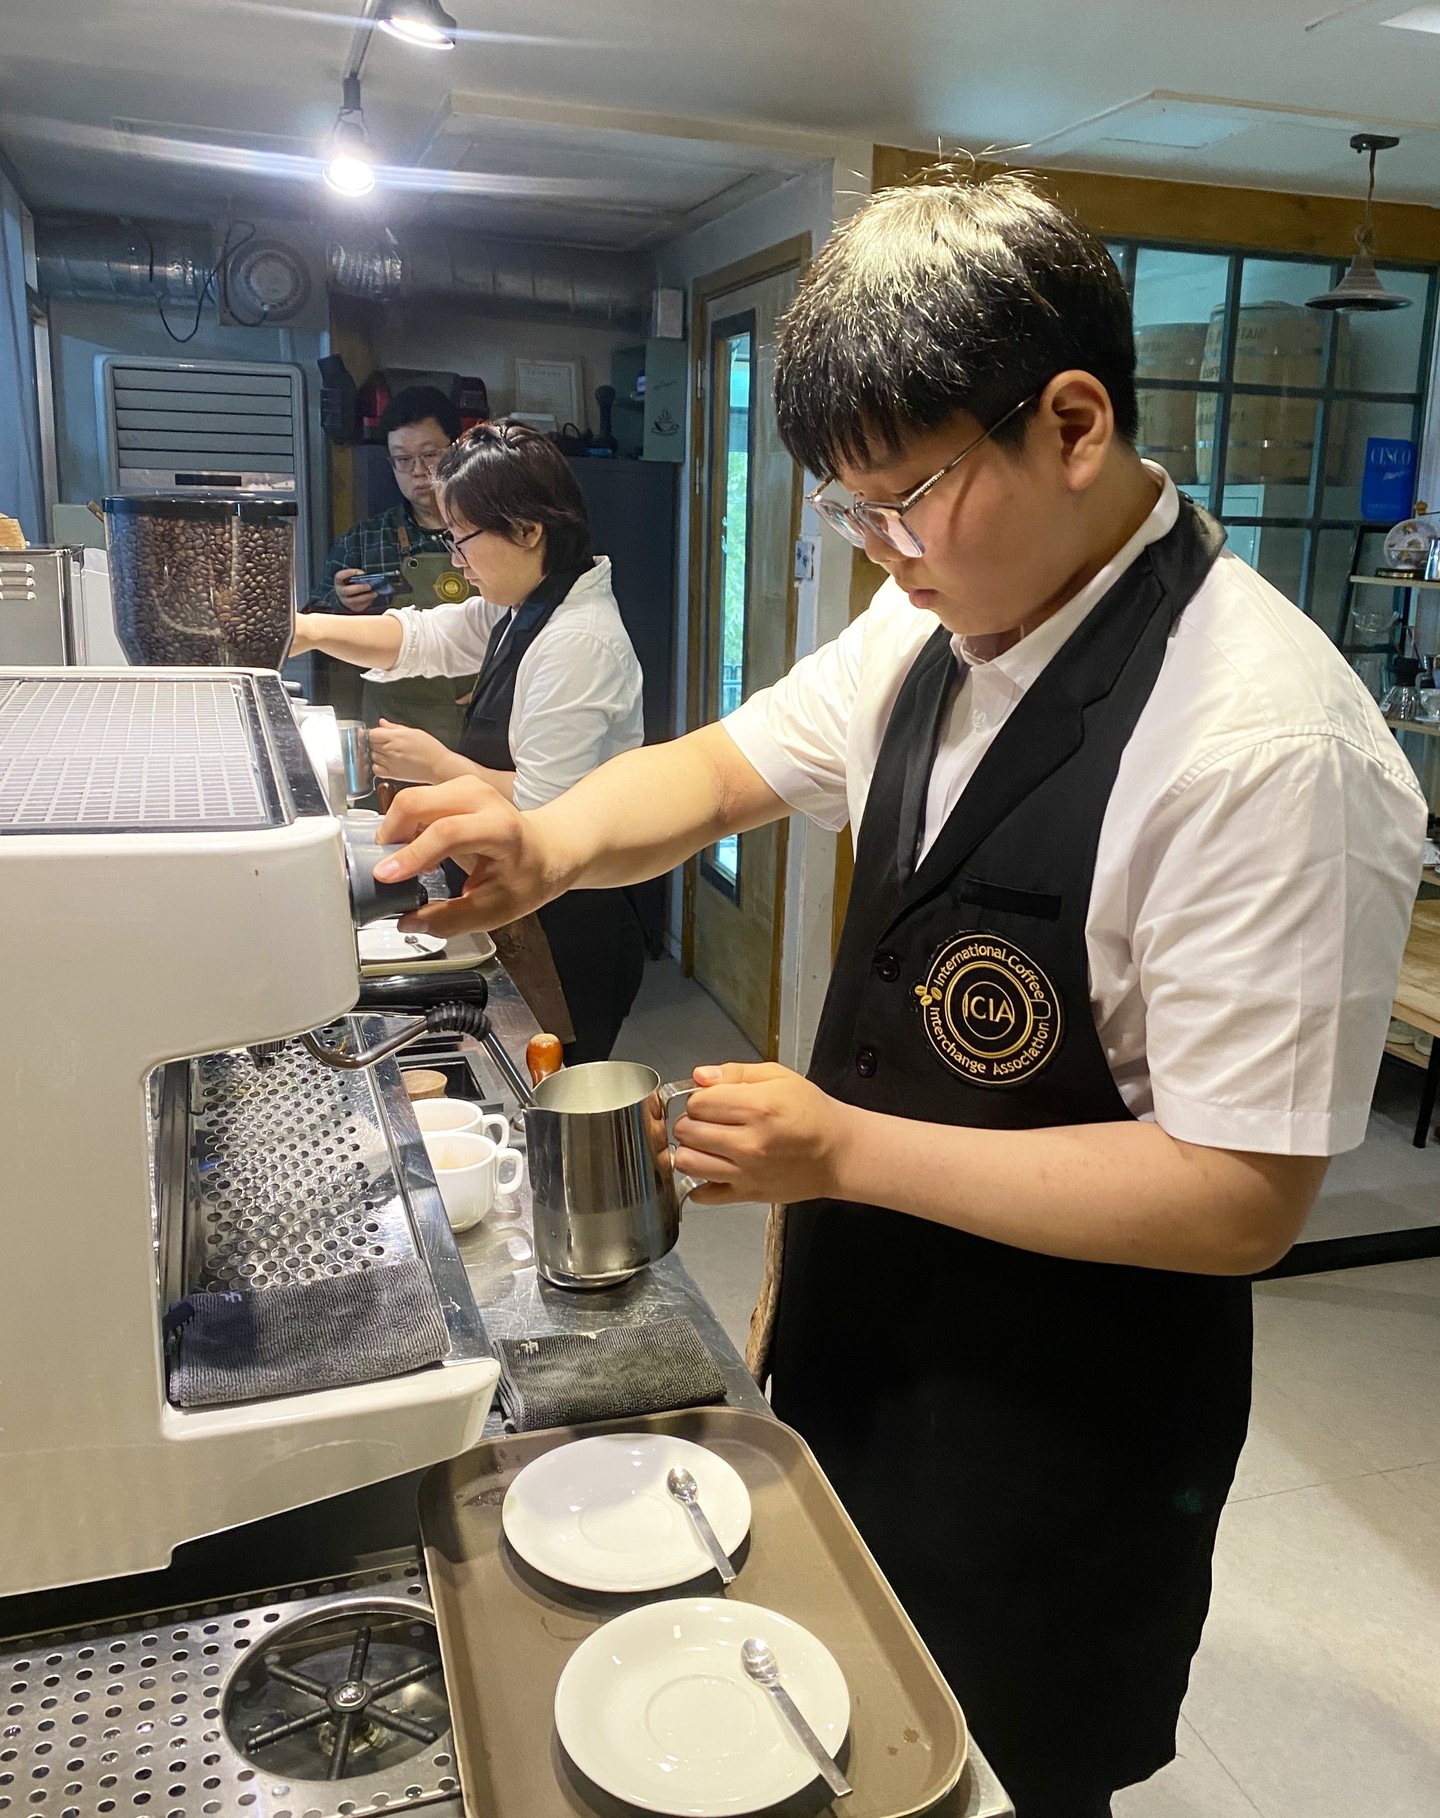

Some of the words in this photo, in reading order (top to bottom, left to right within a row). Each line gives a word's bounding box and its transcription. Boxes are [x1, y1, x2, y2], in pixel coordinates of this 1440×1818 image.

[1370, 447, 1411, 466] CESCO
[933, 943, 1007, 987] International
[1007, 955, 1045, 1000] Coffee
[962, 993, 1015, 1023] ICIA
[930, 1007, 986, 1073] Interchange
[993, 1021, 1049, 1075] Association
